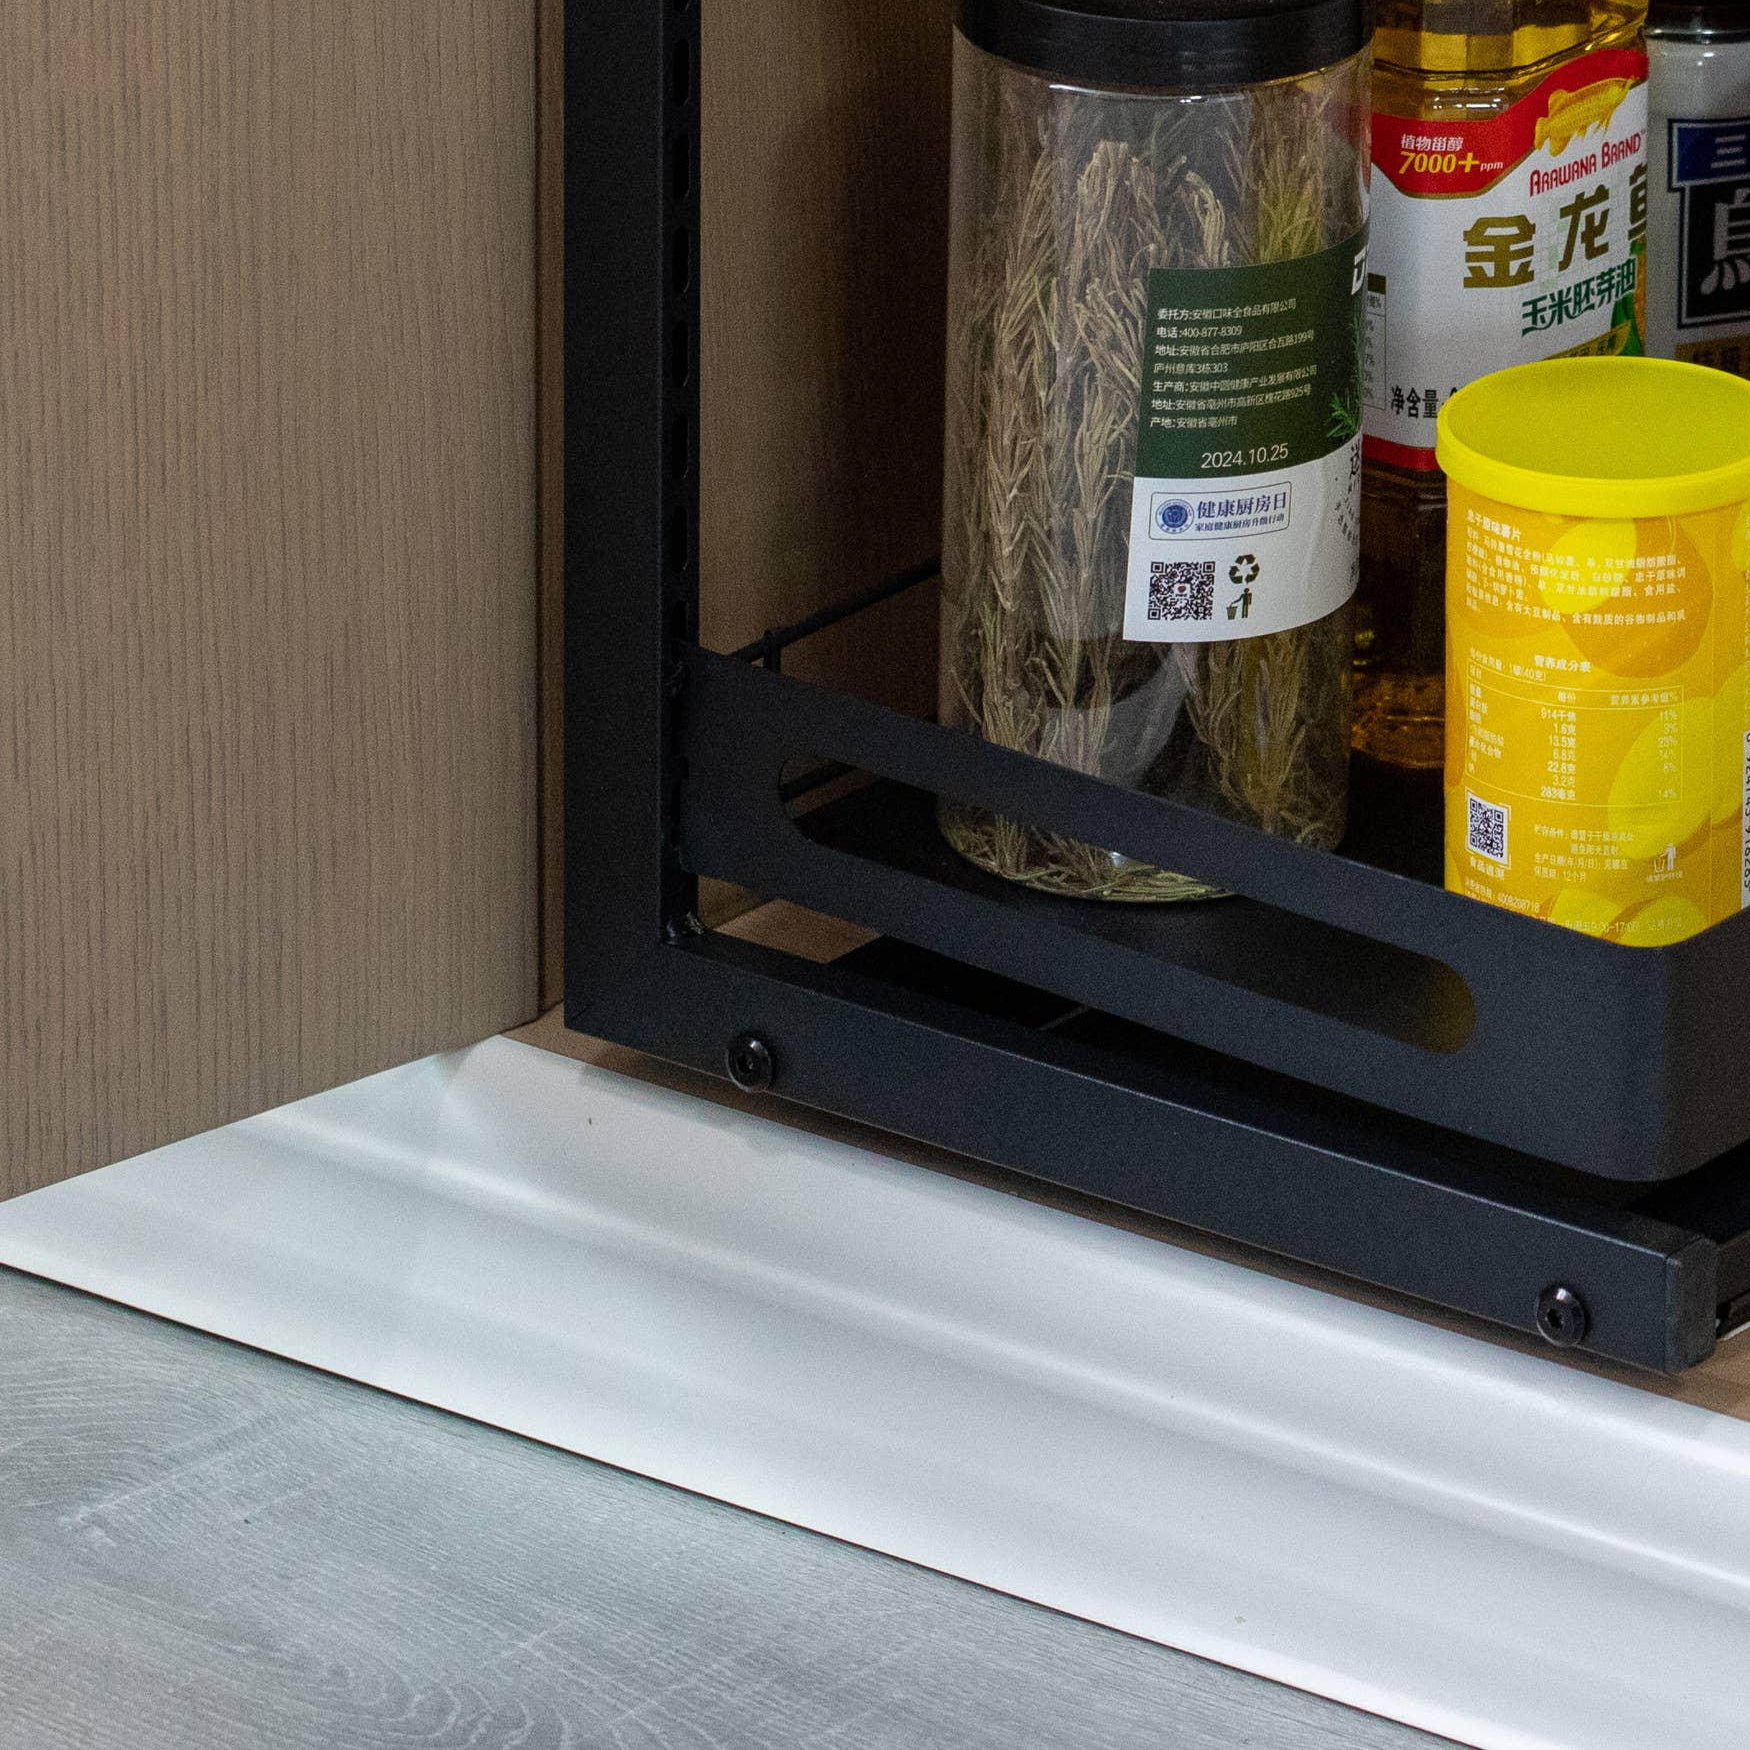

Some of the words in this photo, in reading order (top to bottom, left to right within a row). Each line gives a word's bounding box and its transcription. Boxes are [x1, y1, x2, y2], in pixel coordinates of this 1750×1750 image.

[1401, 133, 1464, 151] 植物甾醇
[1529, 153, 1598, 198] ARAWANA
[1600, 134, 1642, 169] BRAND
[1521, 257, 1637, 338] 玉米胚芽油
[1200, 442, 1290, 469] 2024.10.25
[1197, 491, 1288, 520] 健康厨房日
